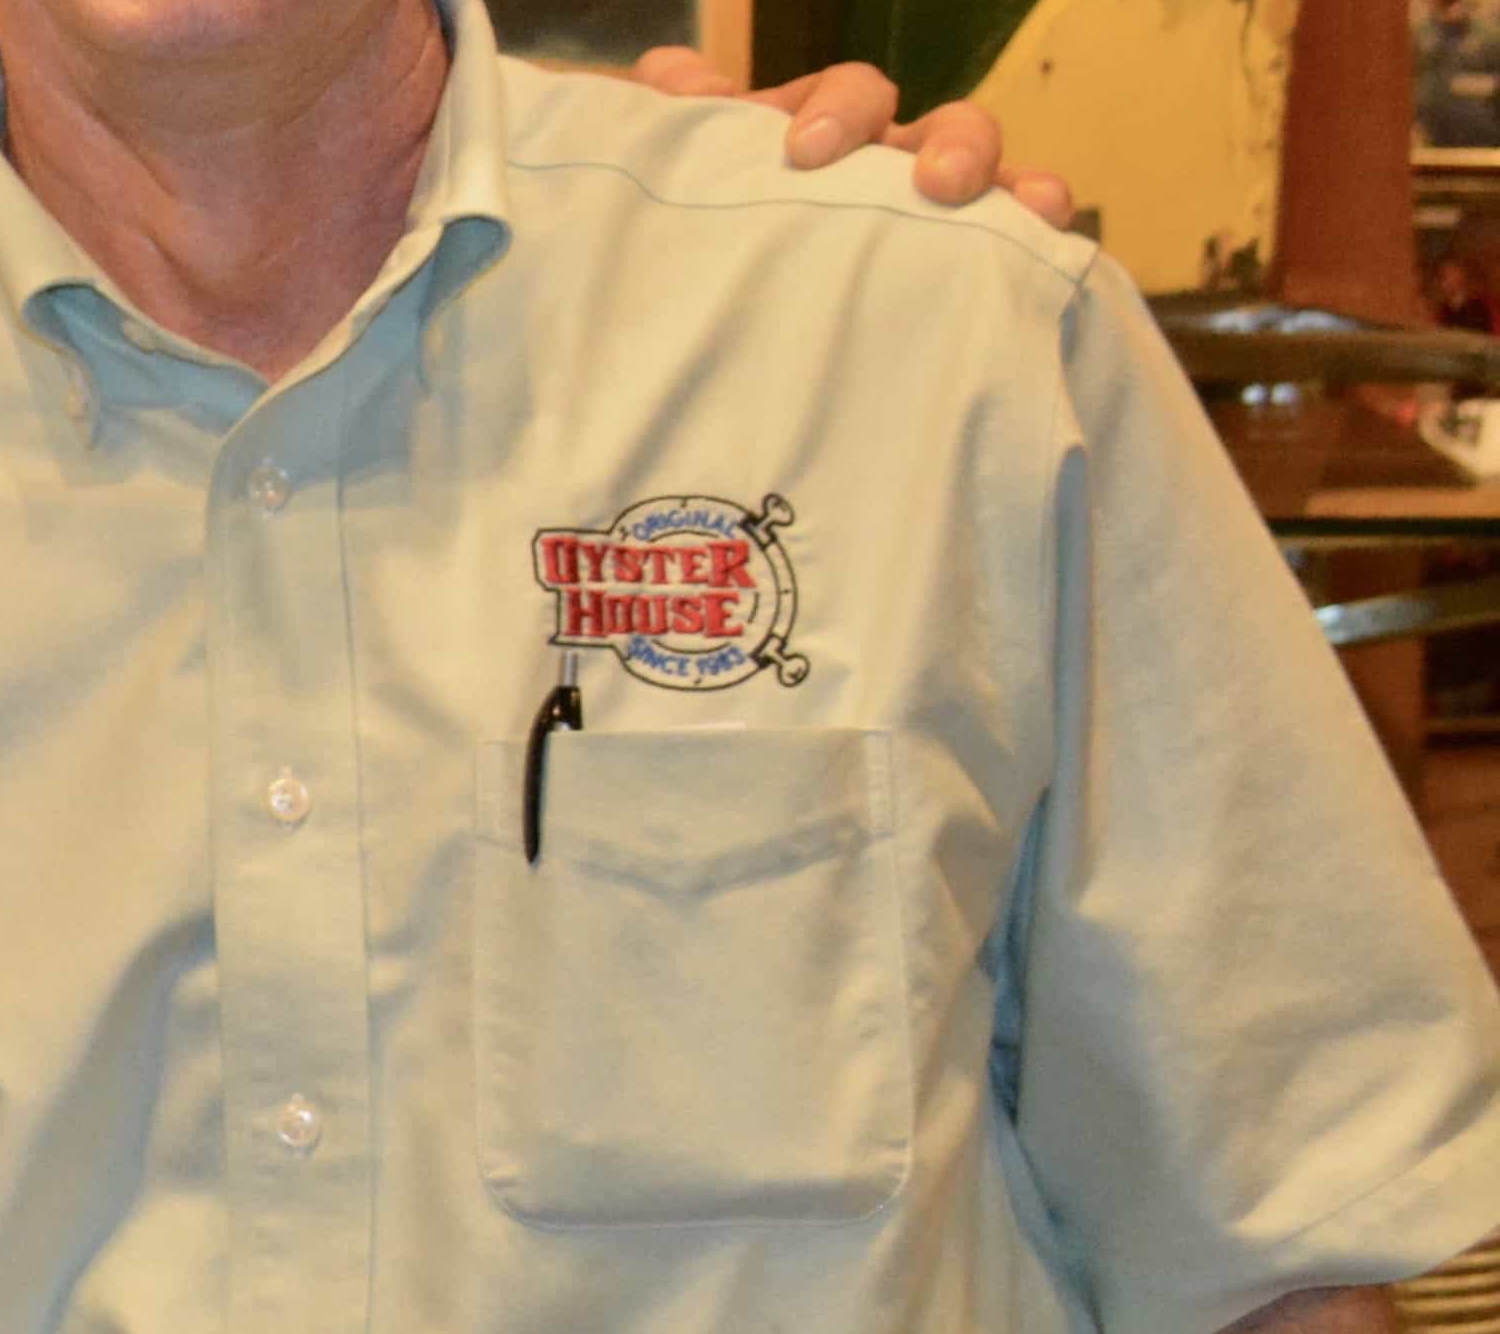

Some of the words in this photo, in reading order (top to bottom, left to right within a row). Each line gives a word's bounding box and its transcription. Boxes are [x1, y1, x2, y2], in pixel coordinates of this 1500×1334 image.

[632, 509, 740, 541] ORIGINAL
[541, 534, 757, 589] OYSTER
[564, 585, 744, 640] HOUSE
[627, 633, 690, 676] SINCE
